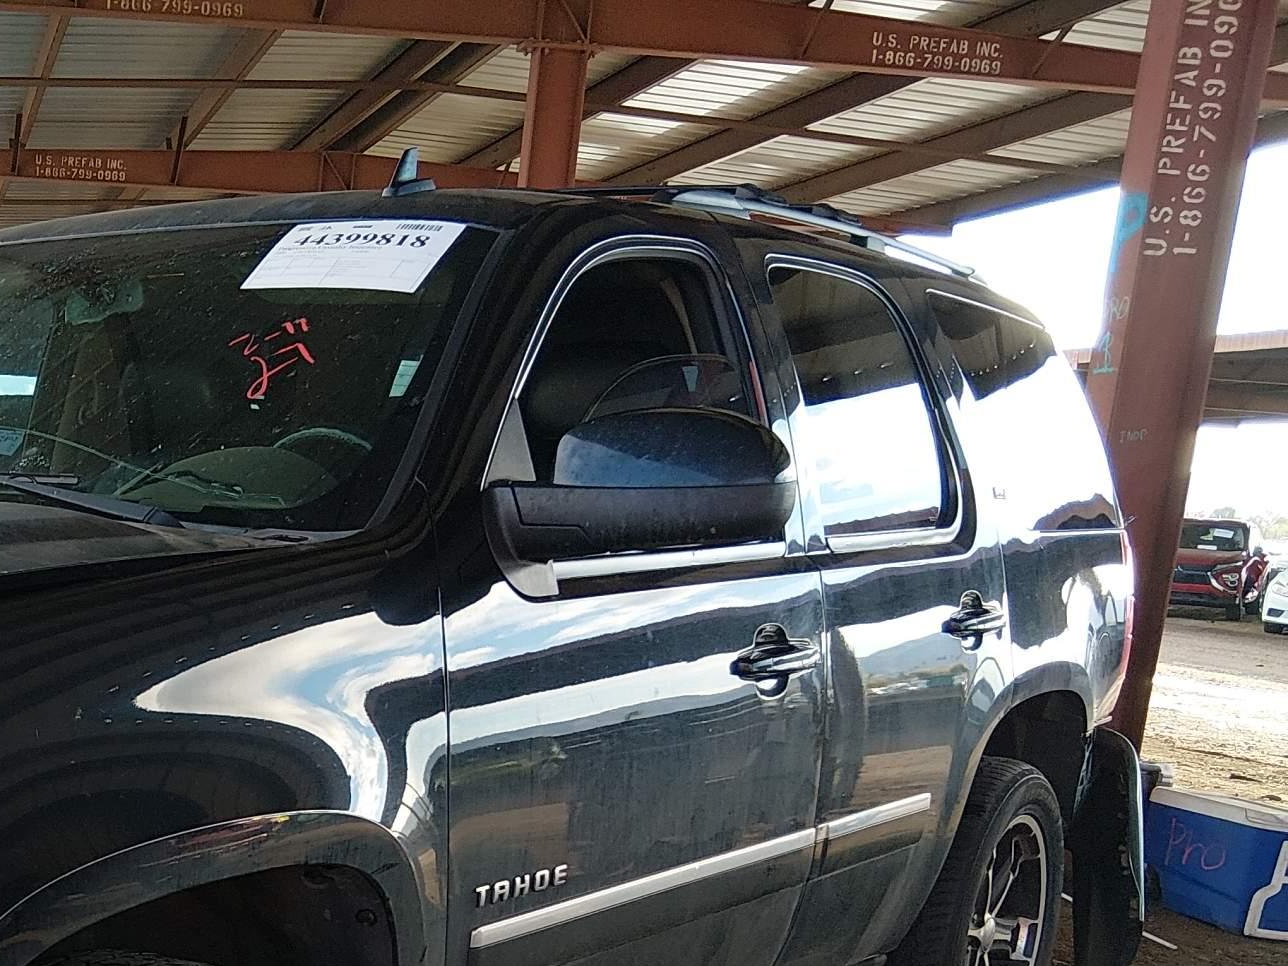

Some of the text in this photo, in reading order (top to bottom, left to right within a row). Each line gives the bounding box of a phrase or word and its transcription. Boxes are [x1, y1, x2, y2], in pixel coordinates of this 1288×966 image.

[872, 31, 1004, 58] U.S. PREFAB INC.
[871, 48, 1001, 74] 1-866-799-0969
[1157, 47, 1202, 175] PREFAB
[35, 154, 127, 170] U.S. PREFAB INC.
[35, 166, 126, 181] 1-866-799-0969
[1143, 196, 1176, 256] U.S.
[295, 233, 431, 248] 44399818
[475, 864, 568, 908] TAHOE
